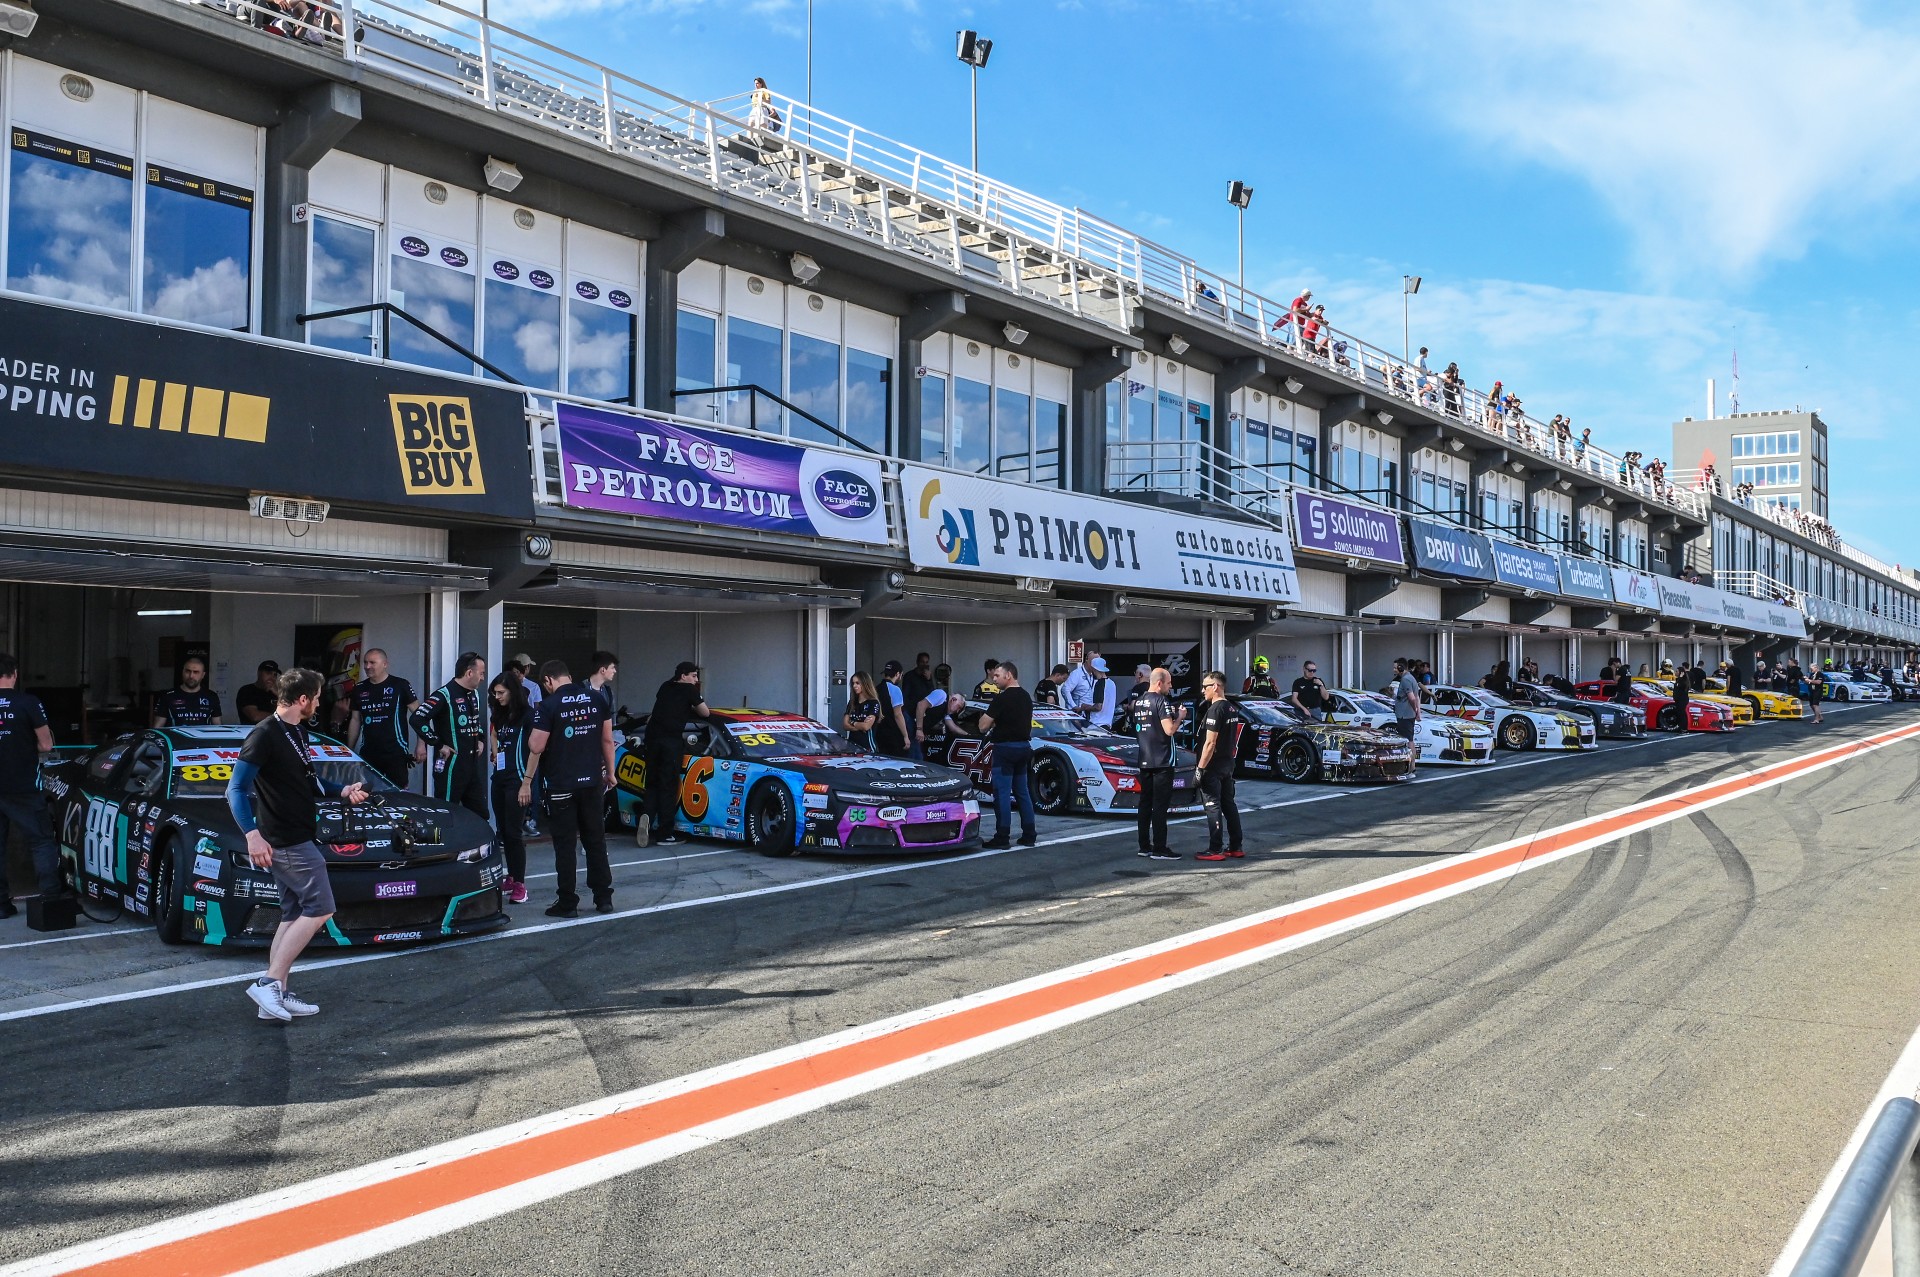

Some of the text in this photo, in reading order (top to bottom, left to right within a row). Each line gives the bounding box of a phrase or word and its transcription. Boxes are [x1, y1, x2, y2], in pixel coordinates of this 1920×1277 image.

[404, 240, 426, 250] FACE
[444, 250, 466, 260] FACE
[496, 264, 516, 274] FACE
[532, 274, 552, 282] FACE
[579, 284, 598, 293] FACE
[611, 293, 629, 302] FACE
[70, 368, 94, 388] IN
[635, 432, 735, 474] FACE
[405, 451, 473, 487] BUY
[570, 462, 794, 520] PETROLEUM
[824, 480, 868, 496] FACE
[824, 496, 870, 508] PETROLEUM
[1330, 506, 1388, 543] solunion
[989, 508, 1140, 570] PRIMOTI
[1176, 530, 1284, 562] automoción
[1334, 541, 1352, 552] SOMOS
[1180, 561, 1290, 595] industrial
[1662, 586, 1692, 610] Panasonic
[1722, 599, 1746, 620] Panasonic
[1768, 610, 1788, 628] Panasonic
[560, 706, 598, 718] wakala
[738, 734, 776, 746] 56
[948, 738, 993, 784] 54
[181, 764, 232, 782] 88
[1118, 778, 1136, 788] 54
[850, 808, 866, 822] 56
[926, 811, 946, 820] Hoosier
[84, 796, 120, 884] 88
[195, 882, 226, 894] KENNOL
[376, 882, 416, 896] Hoosier
[378, 931, 422, 940] KENNOL
